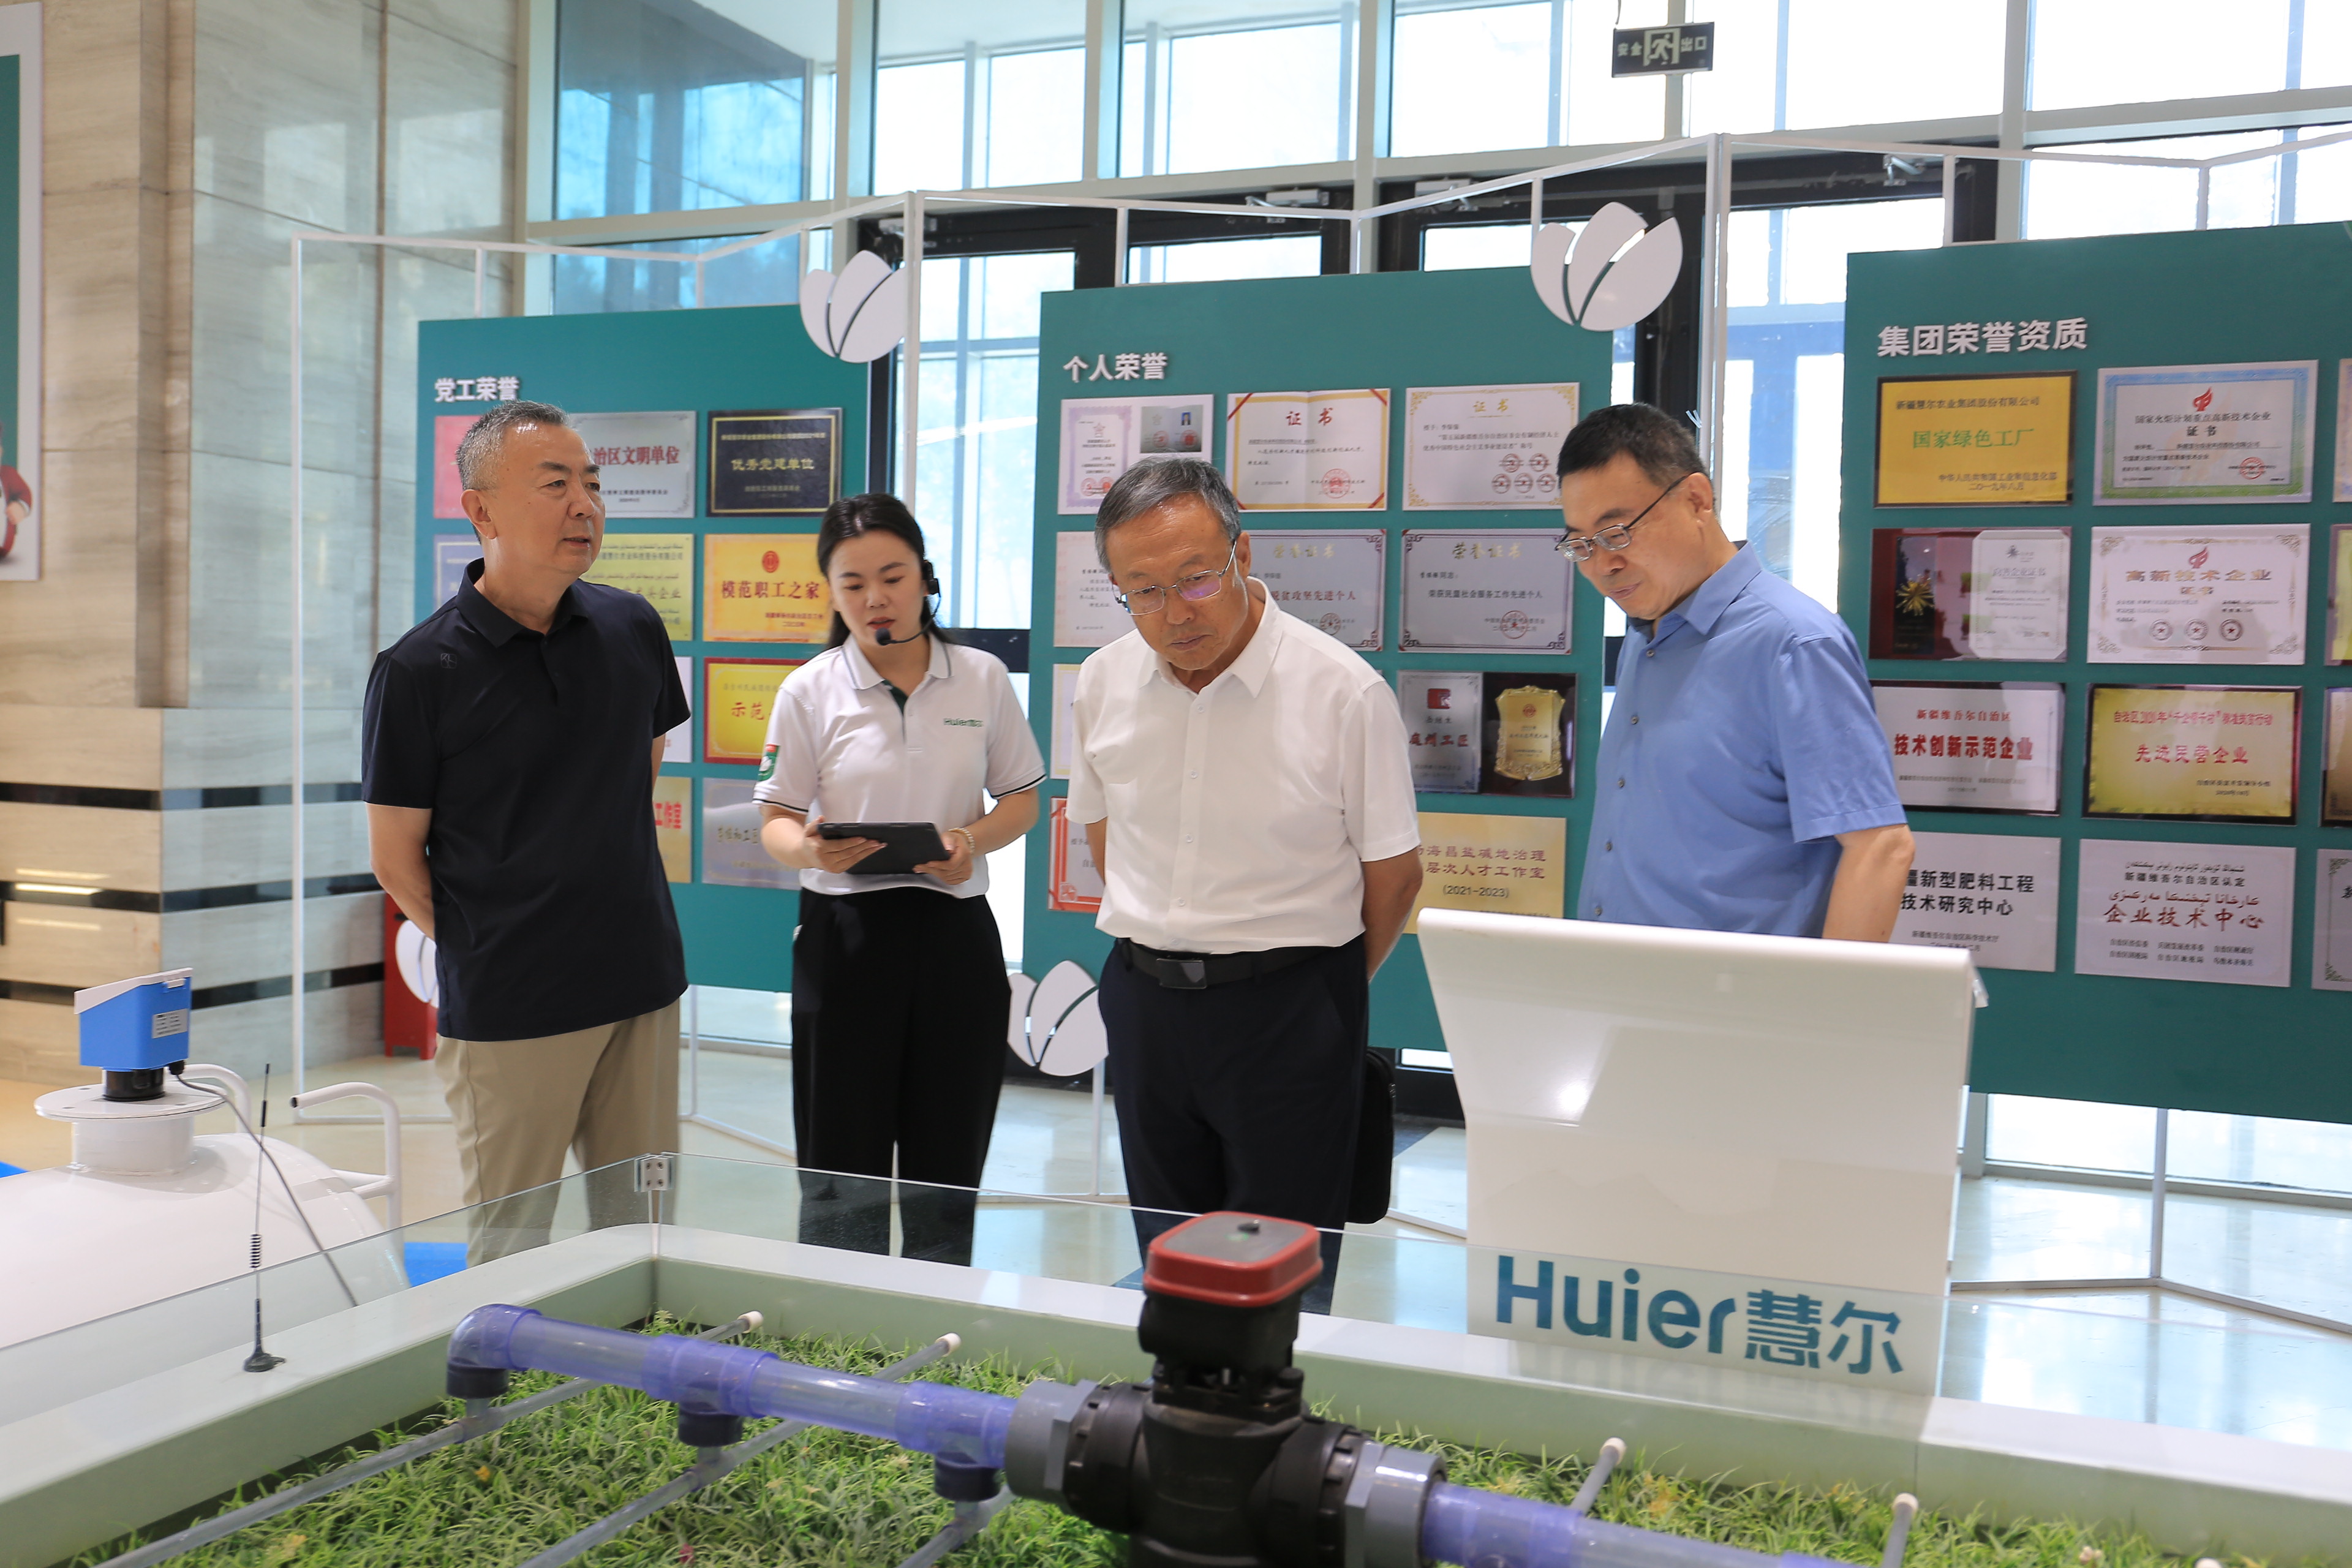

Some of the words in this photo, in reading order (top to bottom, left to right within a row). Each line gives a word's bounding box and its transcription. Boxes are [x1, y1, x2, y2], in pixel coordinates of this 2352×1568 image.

[1681, 36, 1708, 53] 出口
[1877, 317, 2088, 357] 集团荣誉资质
[1063, 352, 1168, 383] 个人荣誉
[434, 376, 519, 402] 党工荣誉
[1473, 399, 1509, 412] 证书
[1286, 407, 1333, 426] 证书
[2135, 412, 2271, 424] 国家火炬计划重点高新技术企业
[1913, 428, 2034, 449] 国家绿色工厂
[2187, 425, 2217, 437] 证书
[731, 458, 815, 471] 优秀党建单位
[1273, 543, 1336, 559] 荣誉证书
[1452, 541, 1521, 560] 荣誉证书
[2125, 570, 2272, 582] 高新技术企业
[722, 580, 820, 600] 模范职工之家
[1271, 590, 1356, 601] 脱贫攻坚先进个人
[2180, 586, 2214, 595] 证书
[1917, 709, 2011, 722] 新疆维吾尔自治区
[1894, 733, 2033, 760] 技术创新示范企业
[2135, 744, 2249, 764] 先进民营企业
[1425, 862, 1546, 879] 层次人才工作室
[2124, 872, 2245, 887] 新疆维吾尔自治区认定
[1442, 884, 1510, 899] (2021-2023)
[1901, 892, 2013, 916] 技术研究中心
[2103, 903, 2265, 932] 企业技术中心
[1496, 1254, 1903, 1375] Huier慧尔
